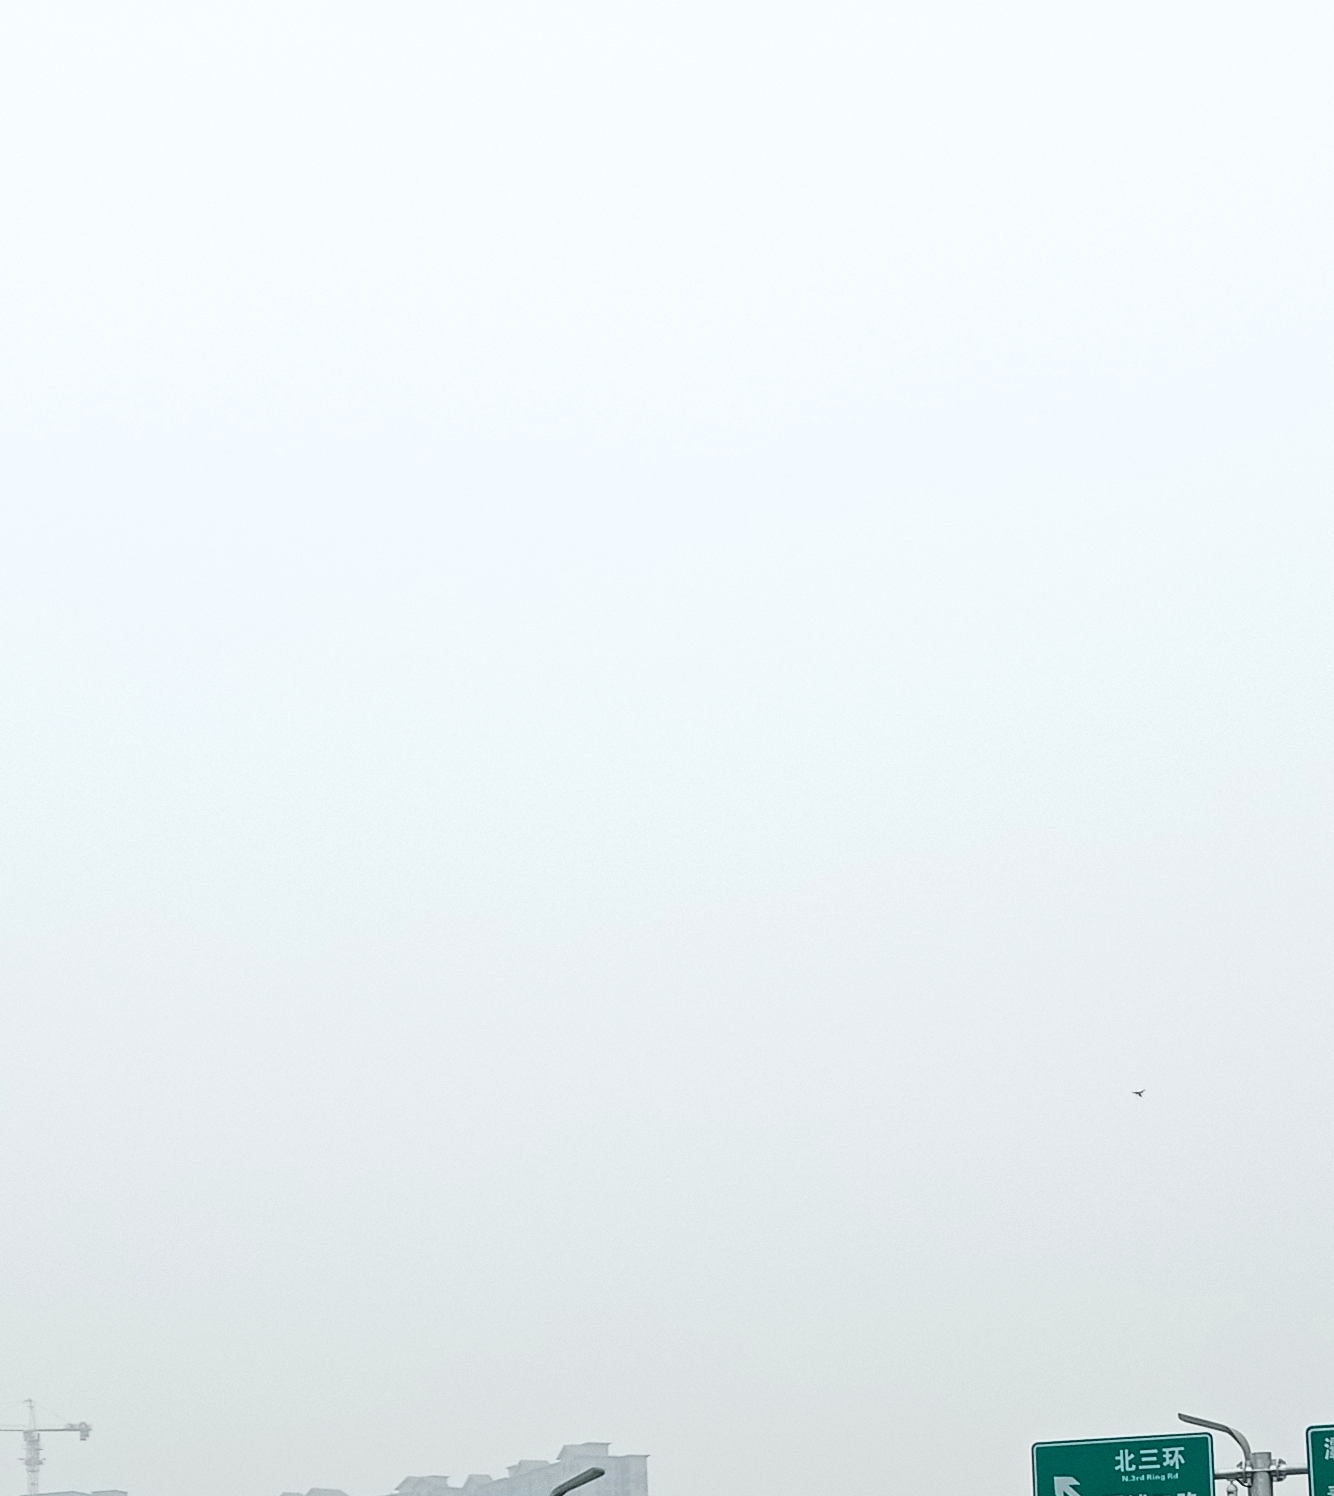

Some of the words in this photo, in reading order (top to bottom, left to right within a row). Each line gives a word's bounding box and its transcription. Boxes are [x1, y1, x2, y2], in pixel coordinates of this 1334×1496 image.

[1114, 1447, 1185, 1472] 北三环
[1146, 1473, 1166, 1481] Ring
[1167, 1472, 1179, 1480] Rd
